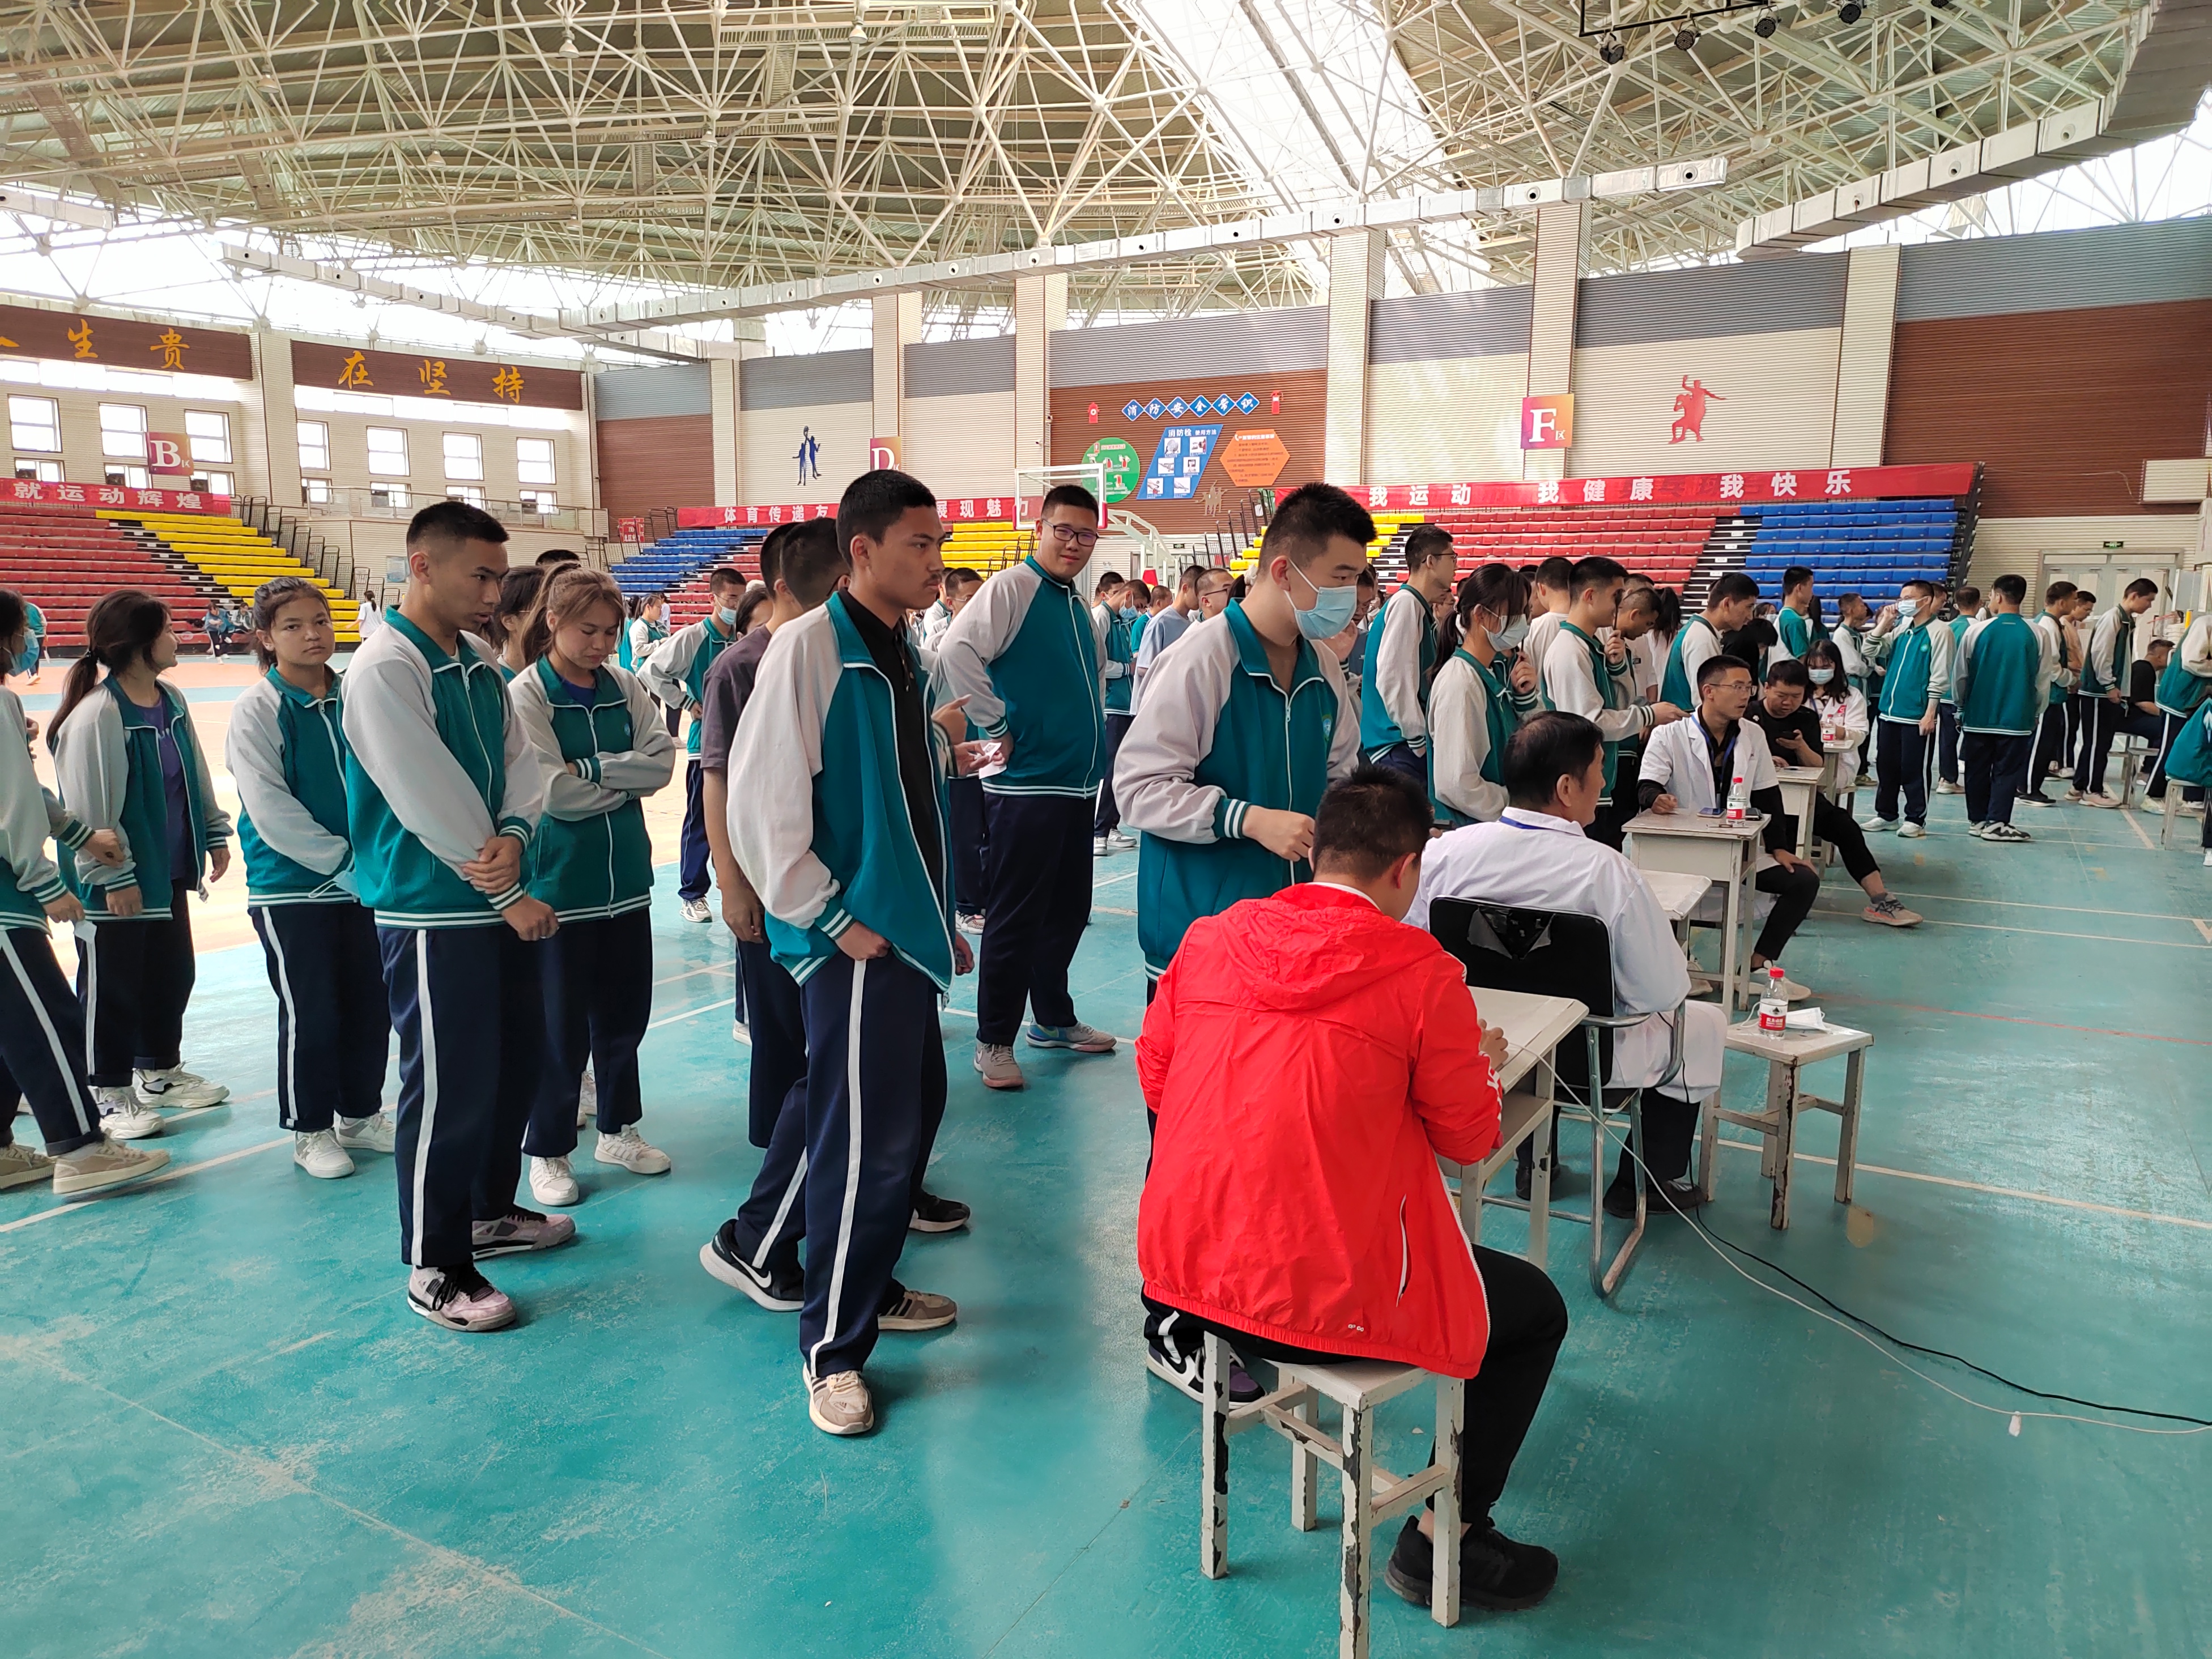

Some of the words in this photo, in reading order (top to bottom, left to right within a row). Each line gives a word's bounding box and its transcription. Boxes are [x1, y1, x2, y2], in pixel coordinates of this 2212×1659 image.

[338, 350, 524, 403] 在坚持
[1127, 397, 1253, 417] 消防安全常识
[14, 482, 203, 509] 就运动辉煌
[1368, 483, 1471, 507] 我运动
[1538, 478, 1653, 505] 我健康
[1720, 470, 1852, 499] 我快乐
